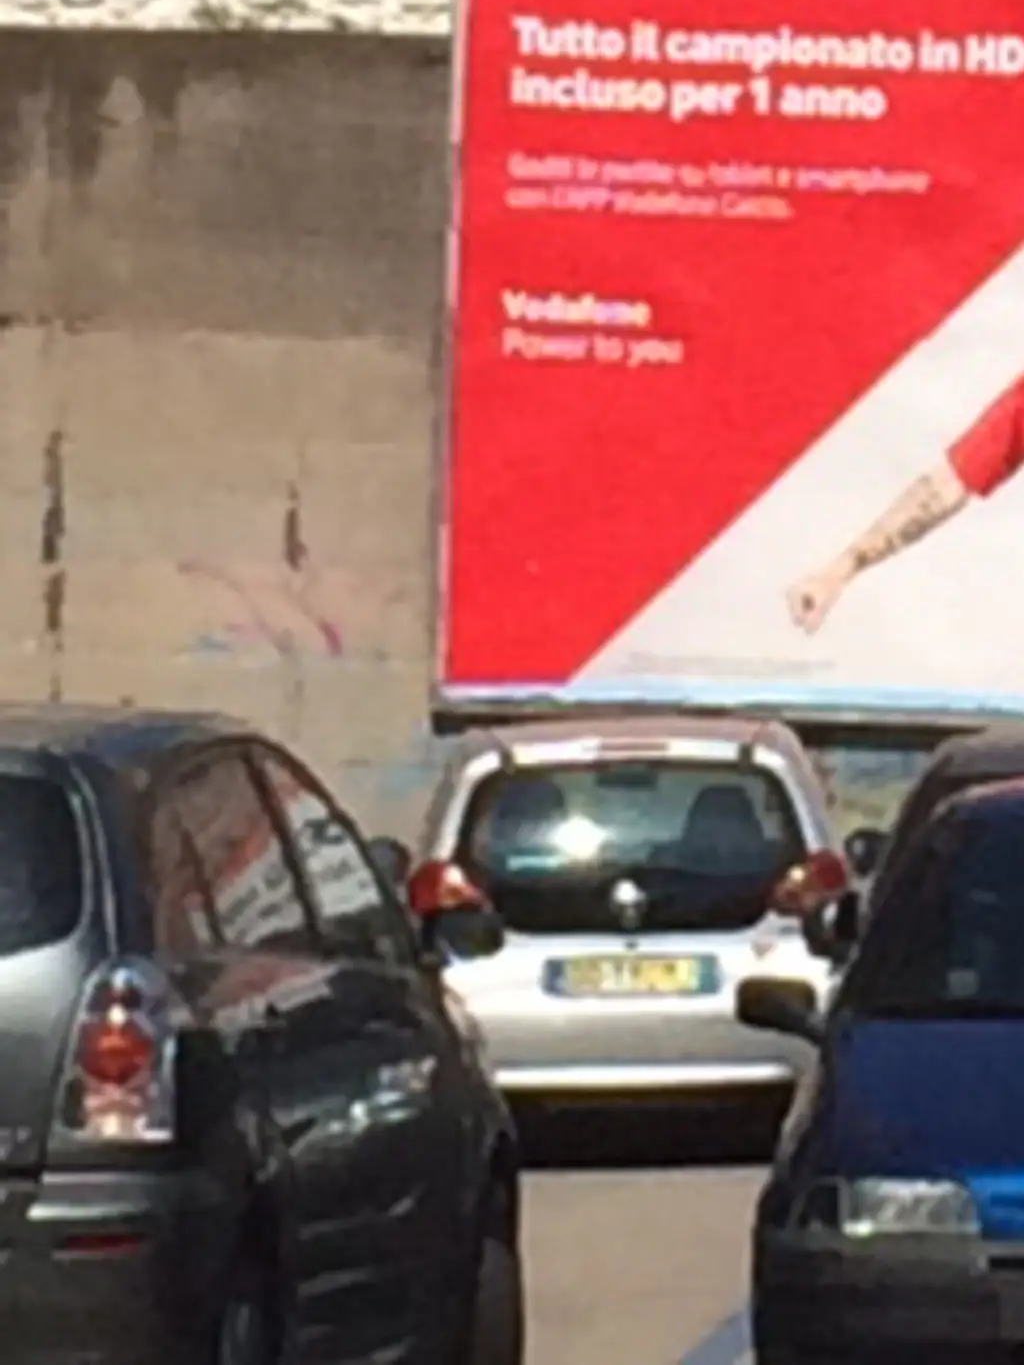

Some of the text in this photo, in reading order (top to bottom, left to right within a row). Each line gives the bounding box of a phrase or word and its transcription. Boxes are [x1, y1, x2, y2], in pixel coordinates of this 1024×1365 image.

[512, 14, 625, 58] Tutto
[630, 18, 661, 62] il
[665, 23, 914, 72] campionato
[918, 30, 961, 72] in
[510, 64, 888, 122] incluso per 1 anno
